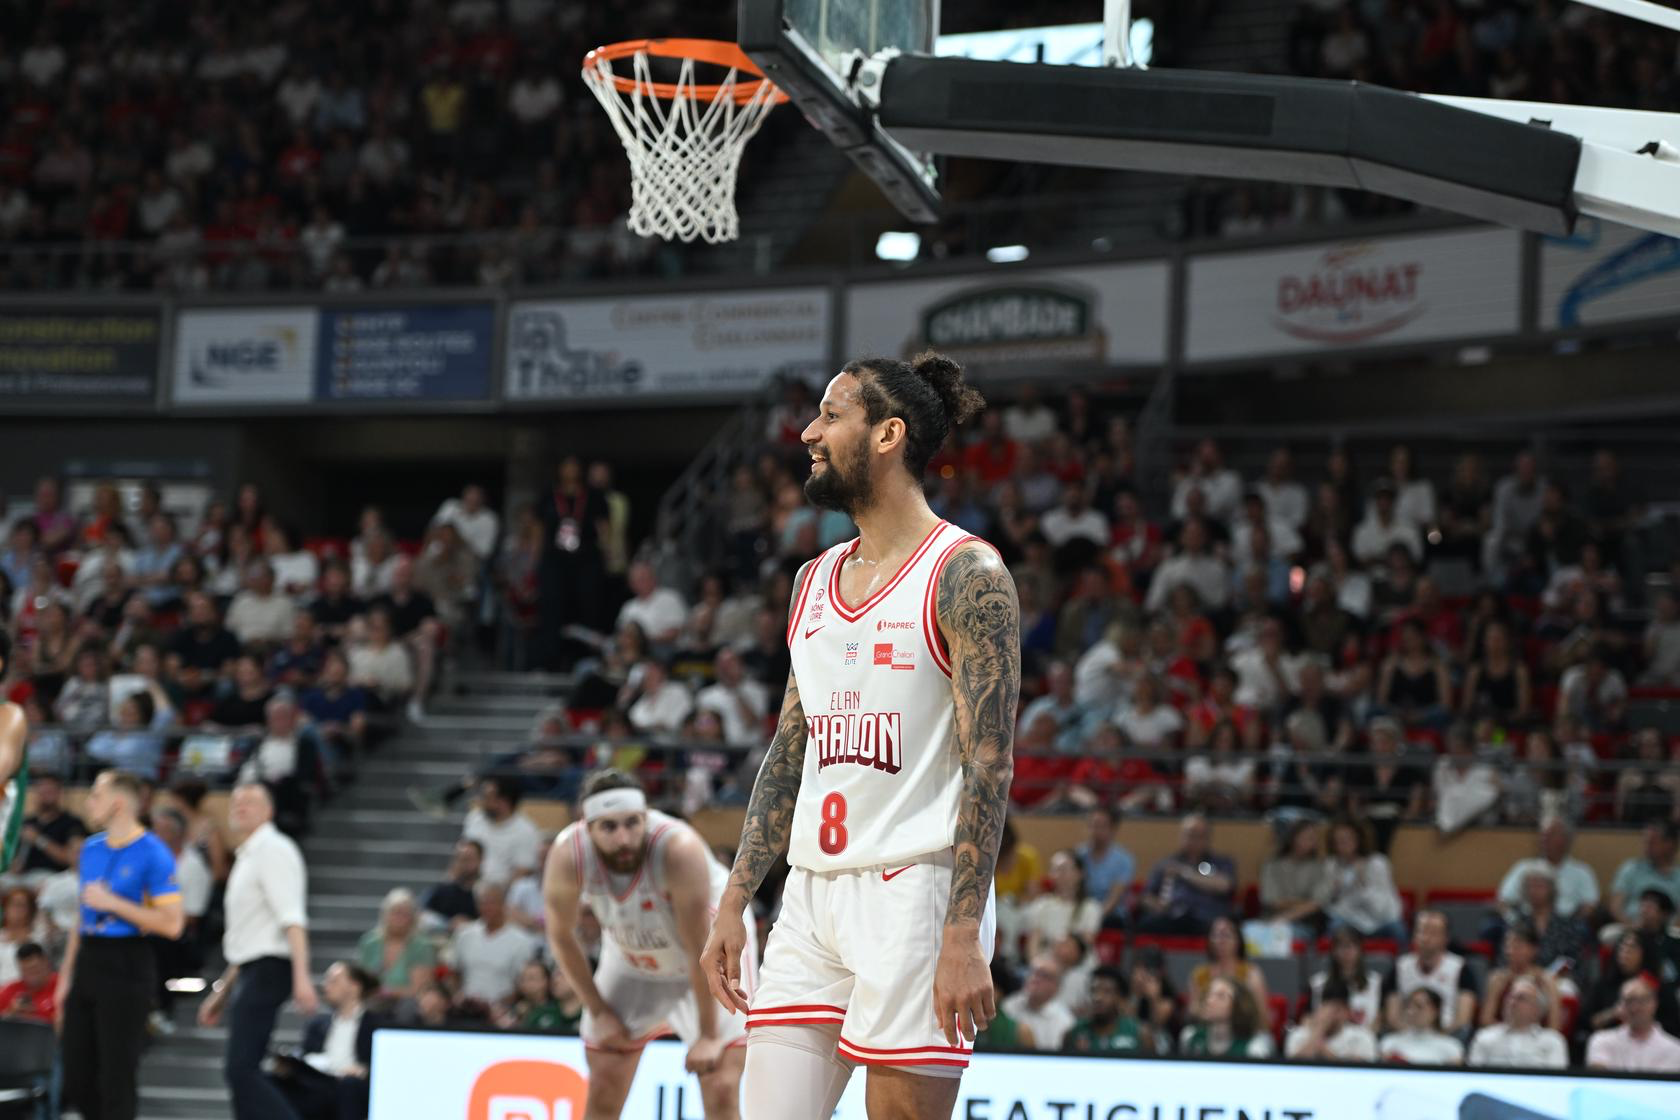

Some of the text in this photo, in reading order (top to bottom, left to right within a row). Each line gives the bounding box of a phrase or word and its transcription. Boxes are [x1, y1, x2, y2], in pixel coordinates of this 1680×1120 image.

[1278, 262, 1423, 315] DAUNAT
[206, 339, 279, 373] NGE
[887, 621, 916, 630] PAPREC
[875, 650, 892, 659] Grand
[830, 691, 861, 711] ELAN
[818, 791, 848, 856] 8
